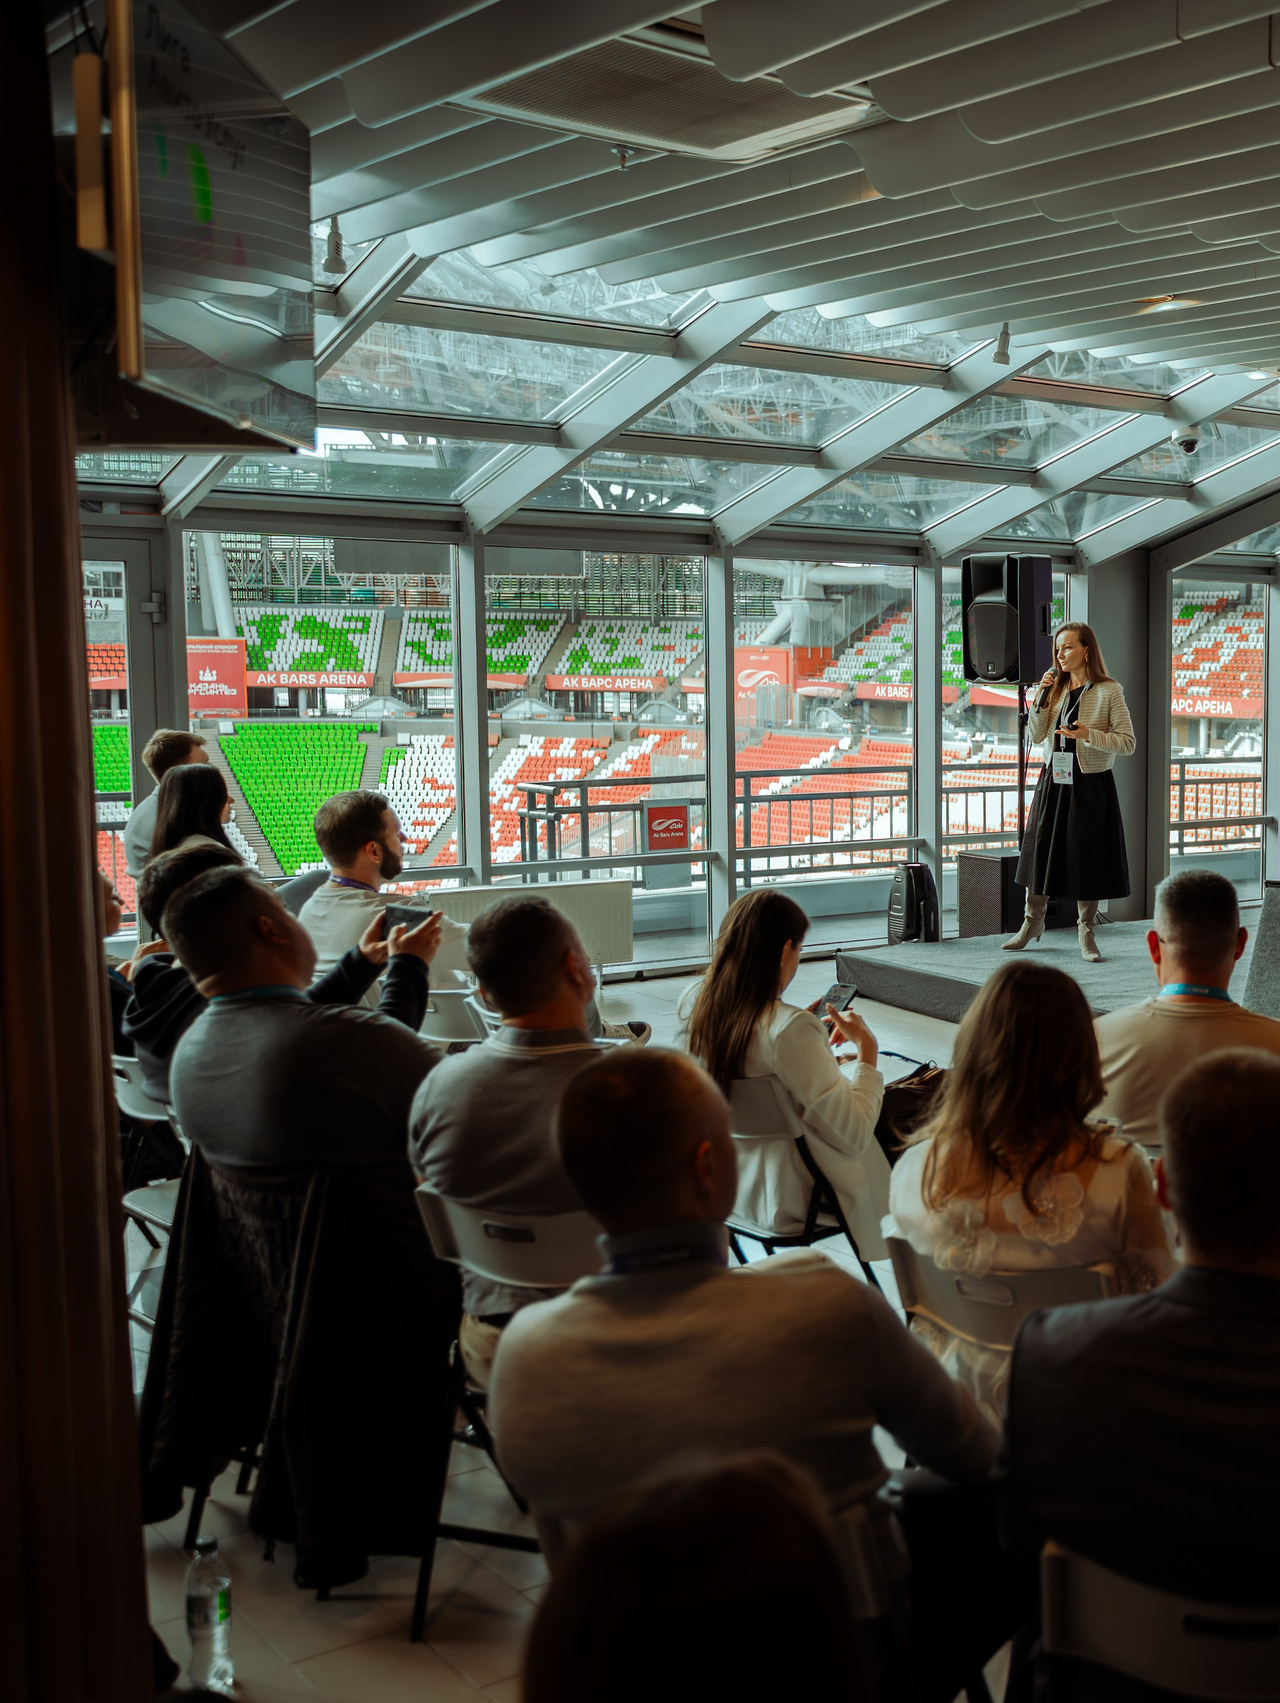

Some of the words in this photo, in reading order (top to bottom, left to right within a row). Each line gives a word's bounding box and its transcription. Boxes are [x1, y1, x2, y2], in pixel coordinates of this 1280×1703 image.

[257, 674, 276, 685] AK
[280, 674, 317, 685] BARS
[320, 674, 367, 685] ARENA
[562, 677, 579, 687] АК
[581, 678, 612, 688] БАРС
[614, 678, 653, 689] АРЕНА
[188, 688, 237, 696] РГСИНТЕЗ
[875, 686, 887, 697] AK
[888, 686, 909, 698] BARS
[1195, 700, 1233, 714] АРЕНА
